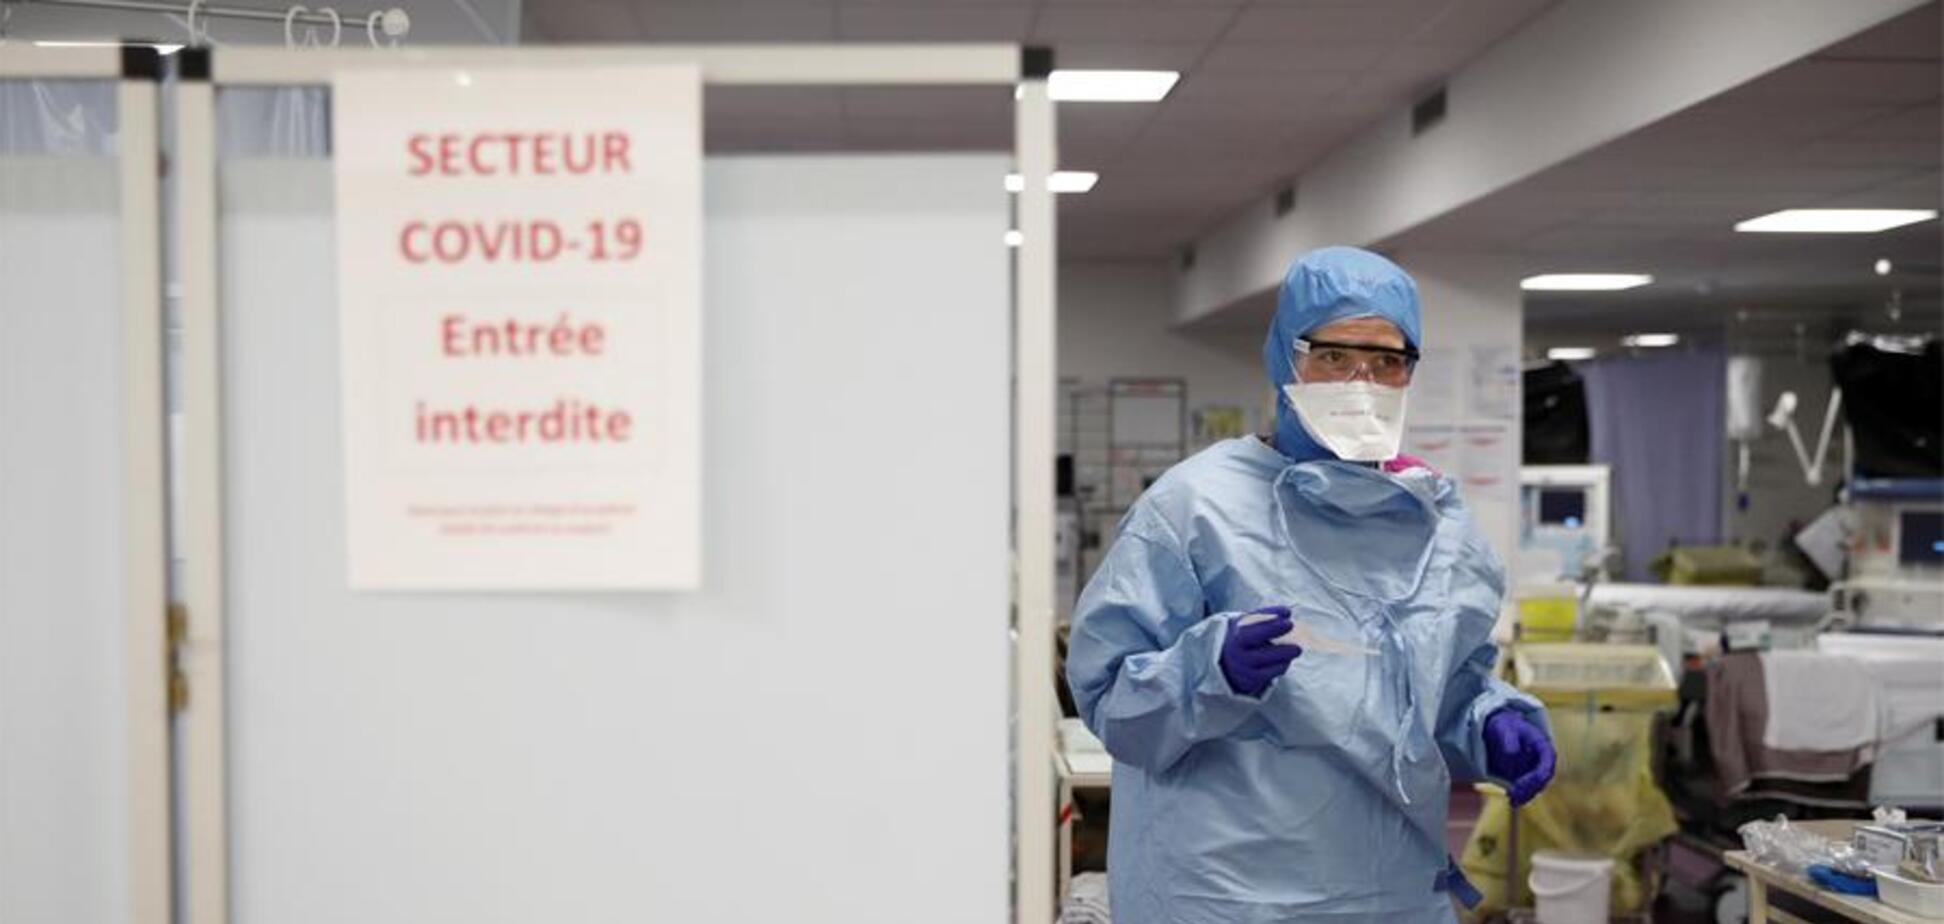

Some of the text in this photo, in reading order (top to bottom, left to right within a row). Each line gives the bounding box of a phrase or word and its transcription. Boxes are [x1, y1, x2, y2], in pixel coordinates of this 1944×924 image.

[406, 131, 632, 175] SECTEUR
[399, 219, 645, 264] COVID-19
[440, 312, 606, 357] Entrée
[414, 399, 632, 444] interdite
